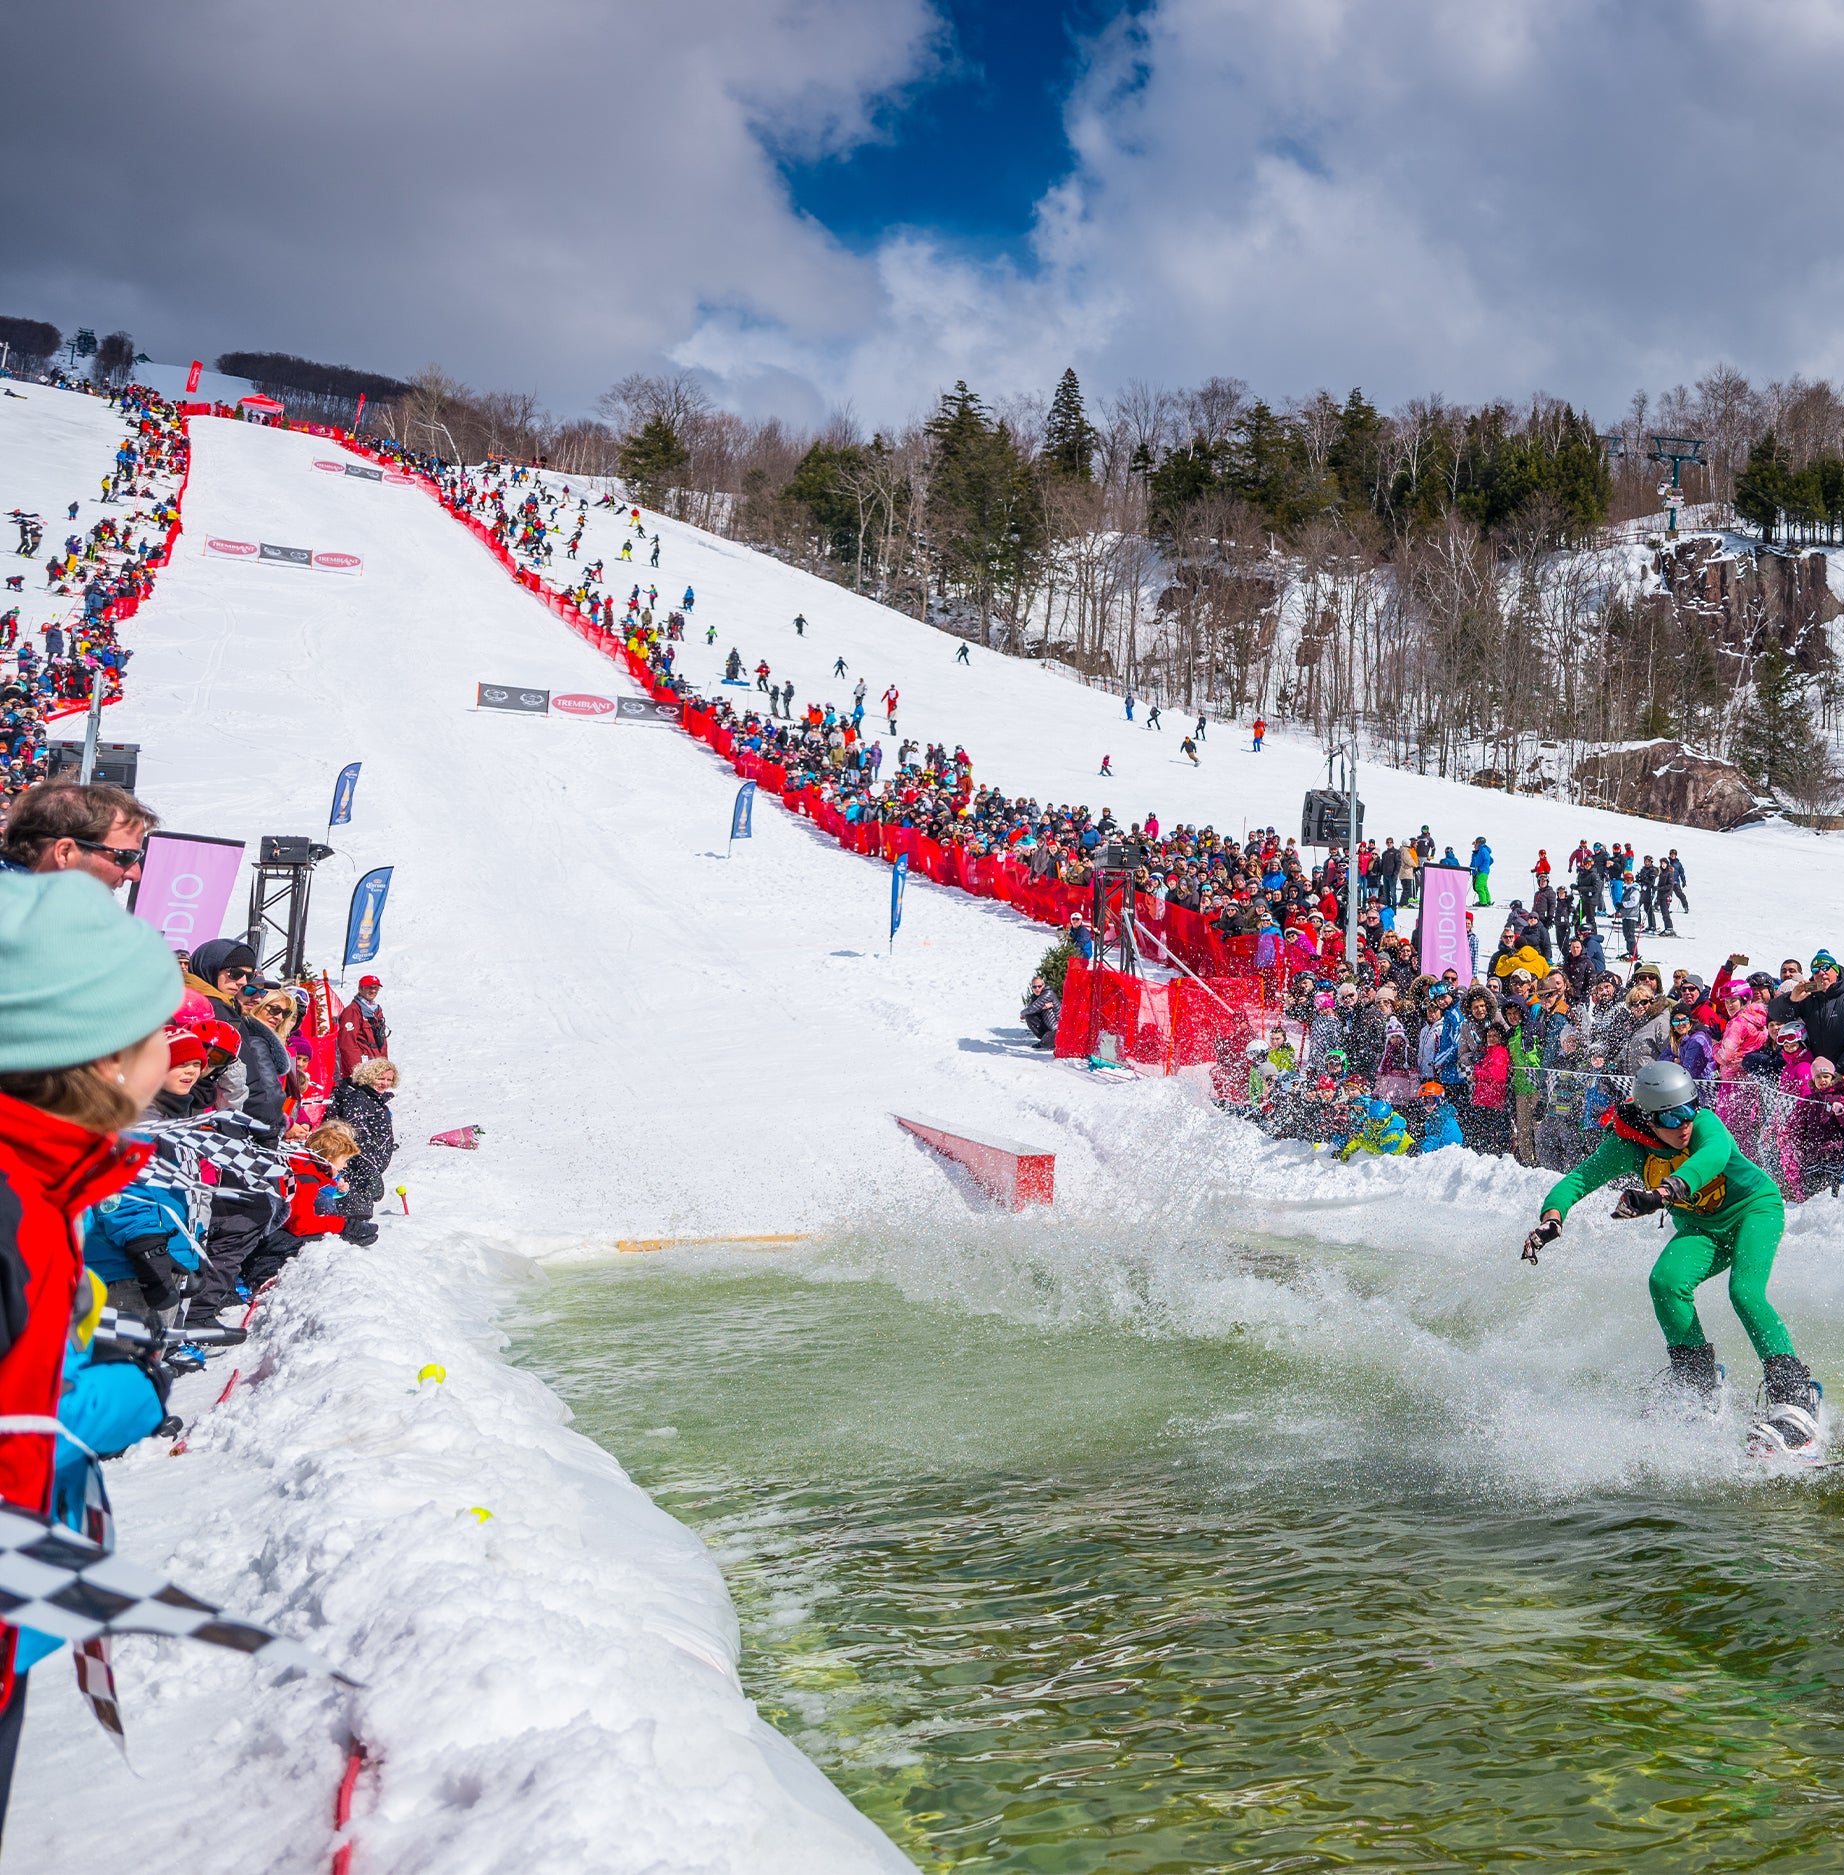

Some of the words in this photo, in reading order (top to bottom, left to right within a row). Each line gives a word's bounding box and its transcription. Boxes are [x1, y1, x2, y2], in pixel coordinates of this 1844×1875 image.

[318, 556, 358, 566] TREMBLANT
[557, 699, 612, 714] TREMBLANT
[1438, 890, 1457, 966] AUDIO
